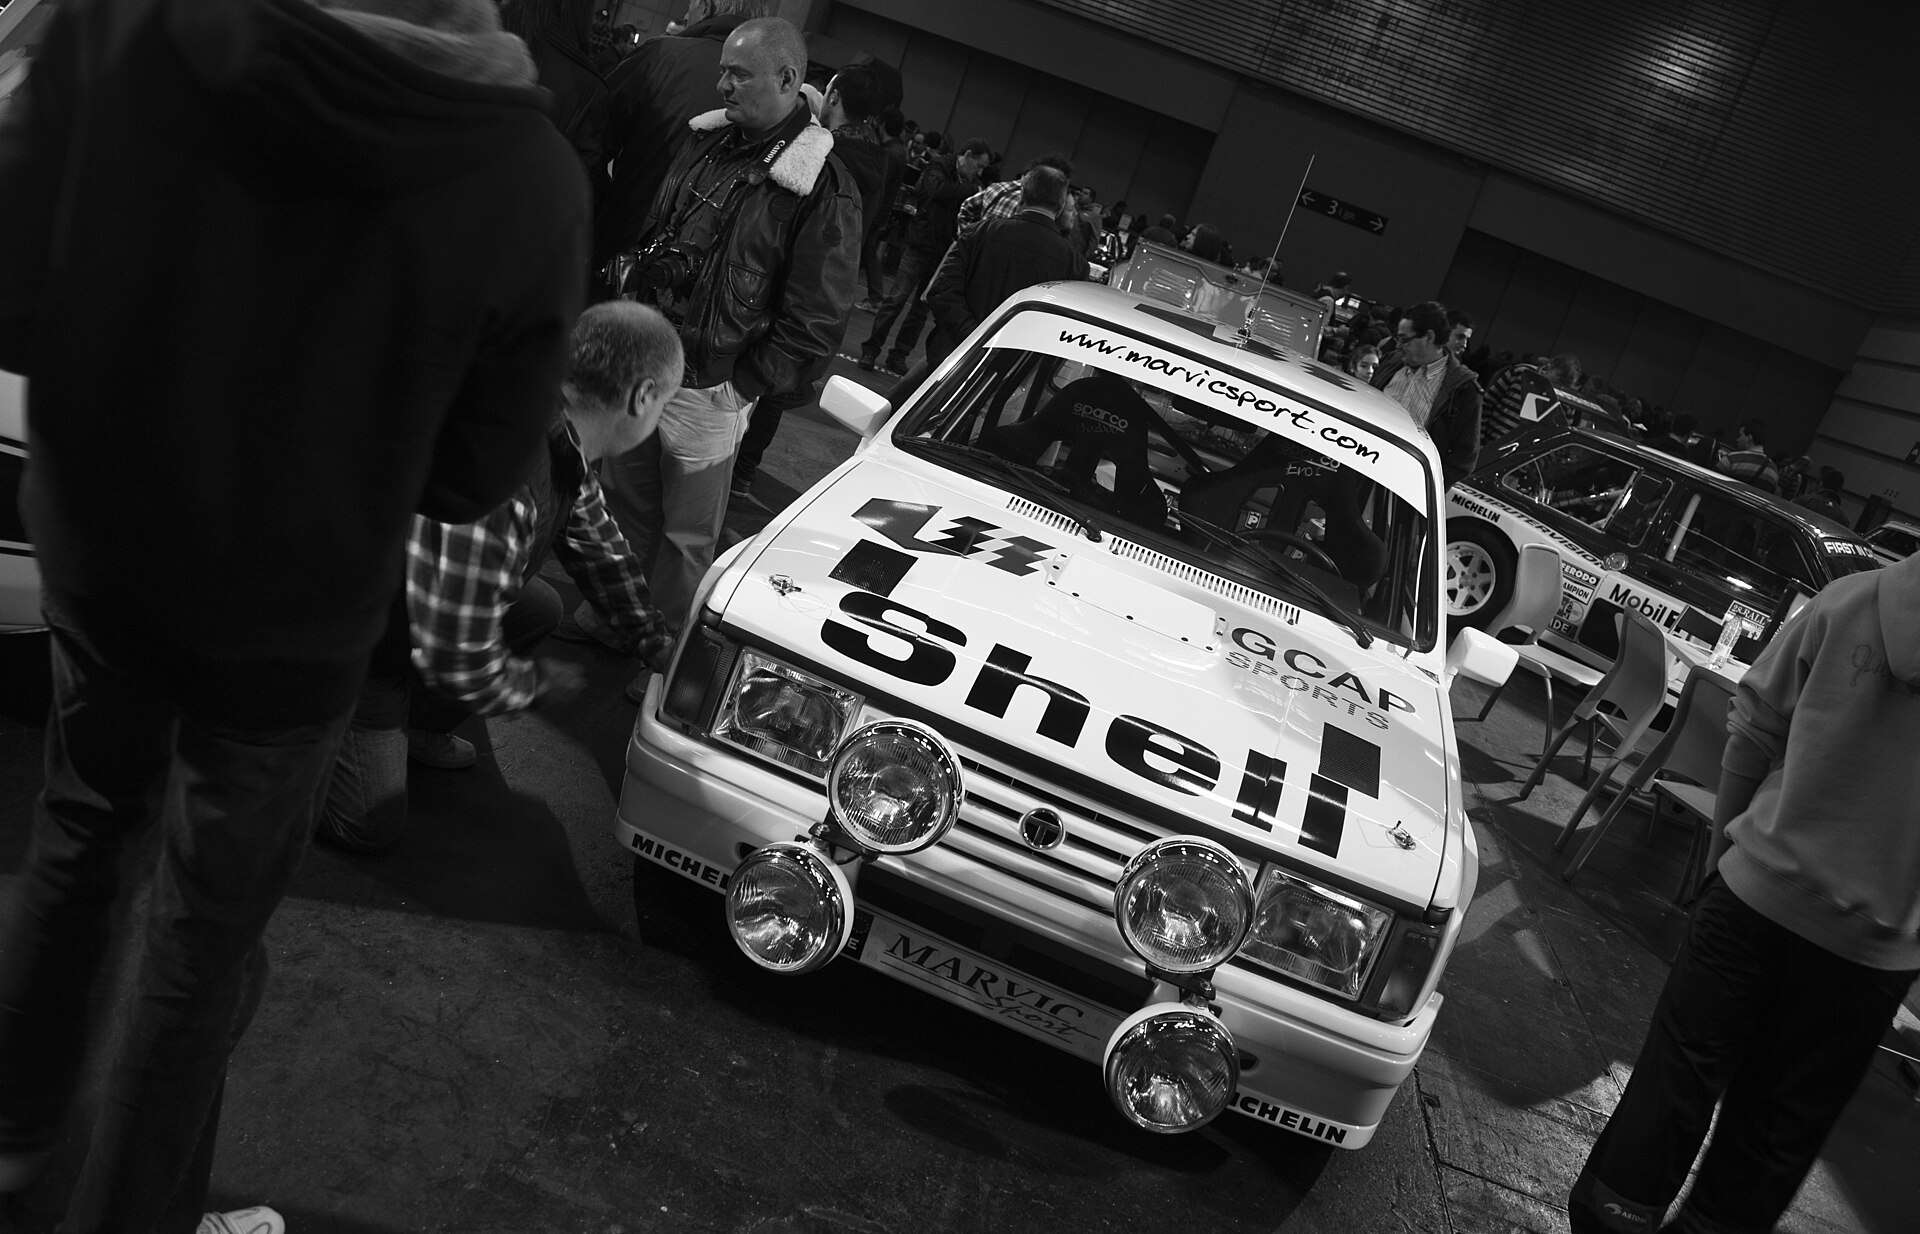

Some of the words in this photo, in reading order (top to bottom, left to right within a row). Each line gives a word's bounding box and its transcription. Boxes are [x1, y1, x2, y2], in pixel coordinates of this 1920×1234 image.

[1060, 330, 1380, 464] www.marvicsport.com
[1073, 403, 1128, 429] sparco
[1452, 495, 1500, 523] MICHELIN
[1824, 541, 1855, 554] FIRST
[1563, 582, 1590, 599] AMPION
[1609, 584, 1667, 623] Mobil
[1225, 651, 1389, 730] SPORTS
[1231, 627, 1416, 713] GCAP
[820, 591, 1349, 859] Shell
[632, 833, 730, 888] MICHEL
[884, 934, 1084, 1018] MARVIC
[985, 996, 1092, 1038] Sport
[1231, 1092, 1347, 1144] ICHELIN
